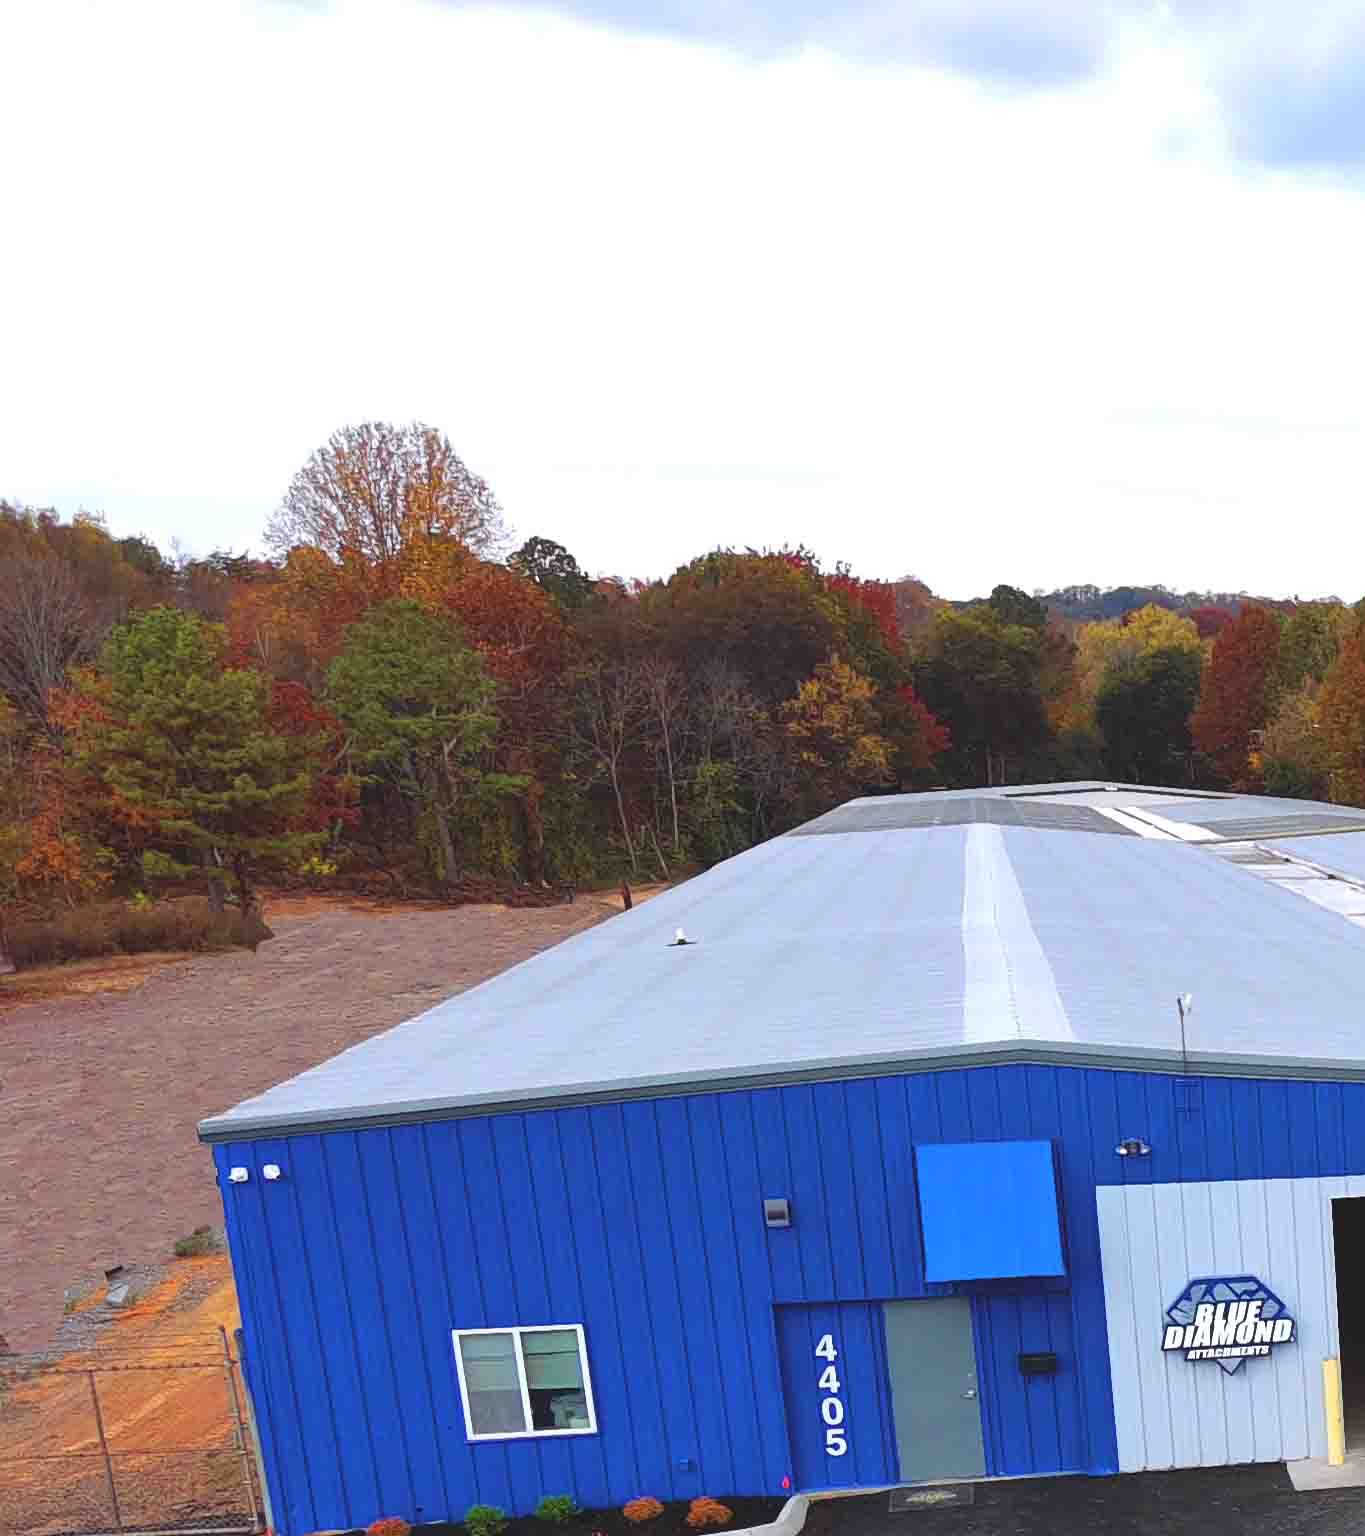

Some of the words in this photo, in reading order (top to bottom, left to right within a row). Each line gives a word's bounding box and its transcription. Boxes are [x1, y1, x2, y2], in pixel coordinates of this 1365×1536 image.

[1194, 1300, 1264, 1326] BLUE
[1163, 1318, 1294, 1350] DIAMOND
[1186, 1345, 1271, 1360] ATTACHMENTS
[815, 1333, 848, 1457] 4405
